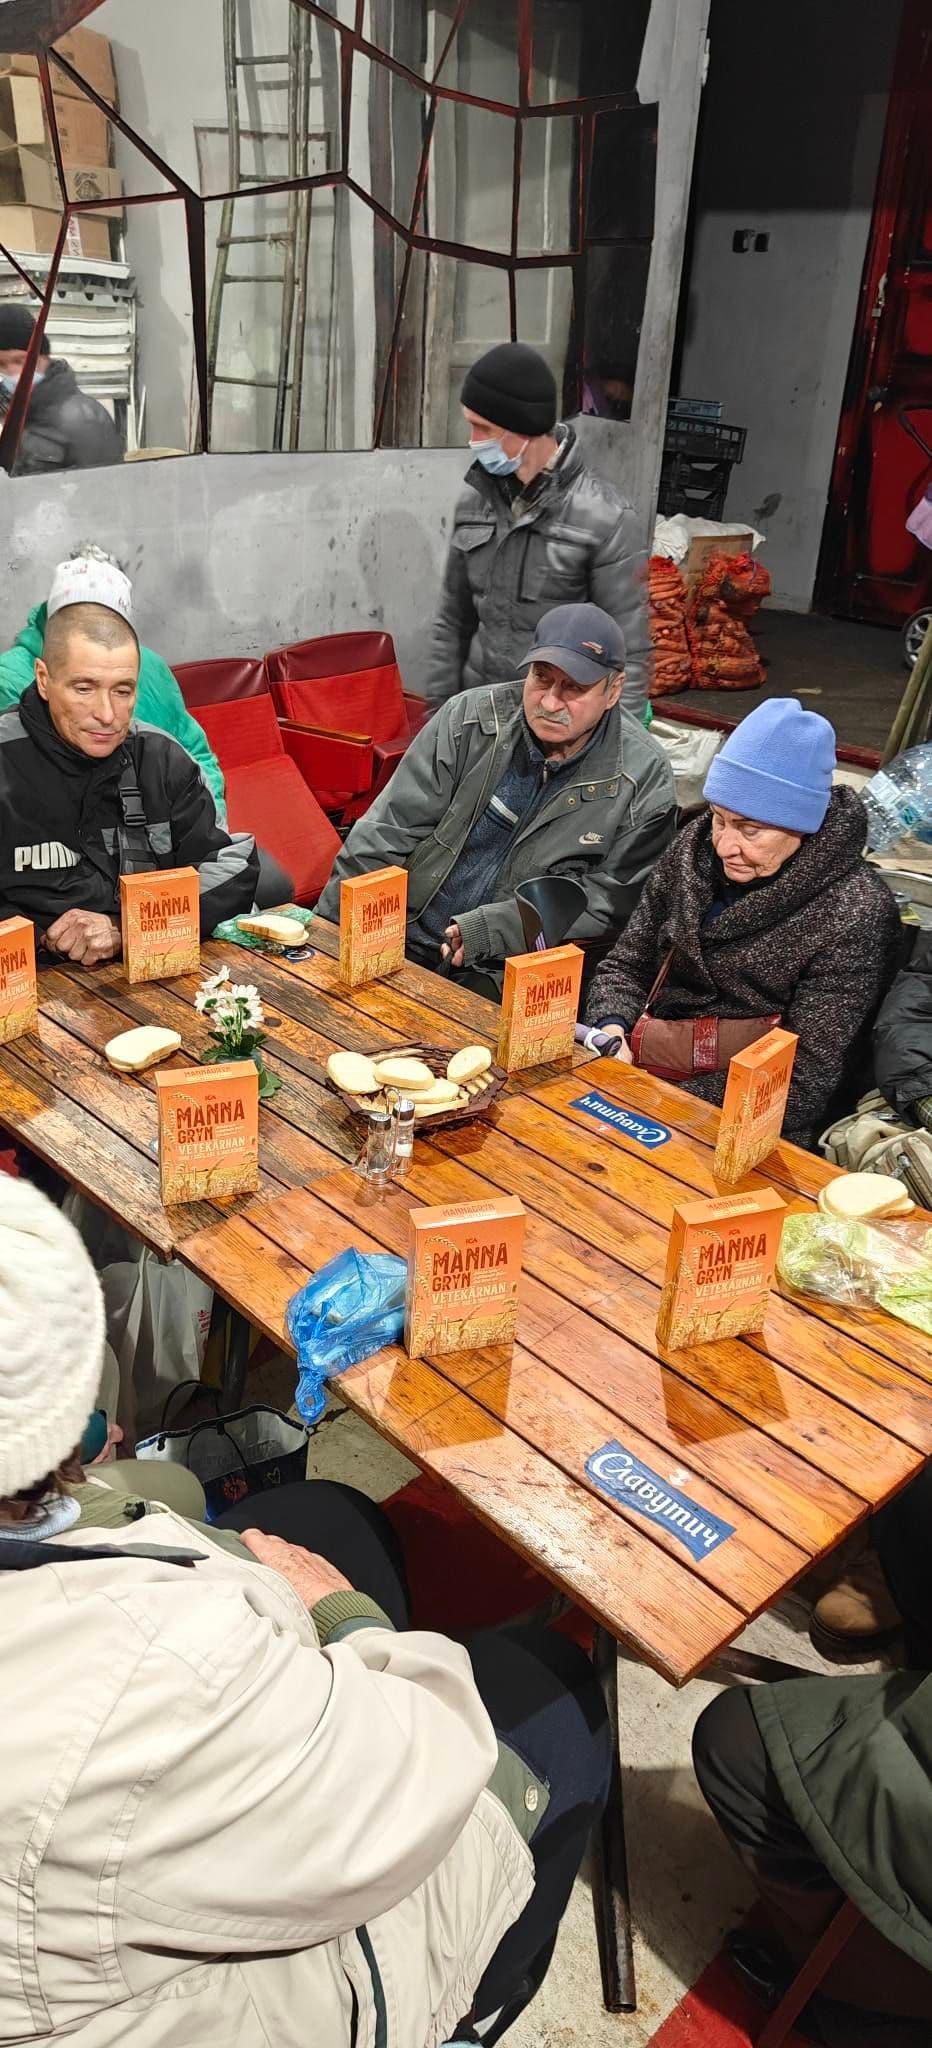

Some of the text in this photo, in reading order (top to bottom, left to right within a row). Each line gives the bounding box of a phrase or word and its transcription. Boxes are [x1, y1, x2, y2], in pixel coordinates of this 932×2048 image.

[139, 895, 191, 920] MANNA
[362, 894, 400, 921] MANNA
[140, 917, 168, 932] GRYN
[362, 917, 383, 934] GRYN
[525, 975, 572, 1005] MANNA
[524, 1000, 550, 1018] GRYN
[176, 1098, 245, 1130] MANNA
[580, 1096, 667, 1143] Славутич
[177, 1126, 213, 1144] GRYN
[432, 1242, 508, 1276] MANNA
[698, 1233, 766, 1270] MANNA
[432, 1272, 471, 1292] GRYN
[696, 1264, 733, 1286] GRYN
[592, 1452, 720, 1548] Славутич
